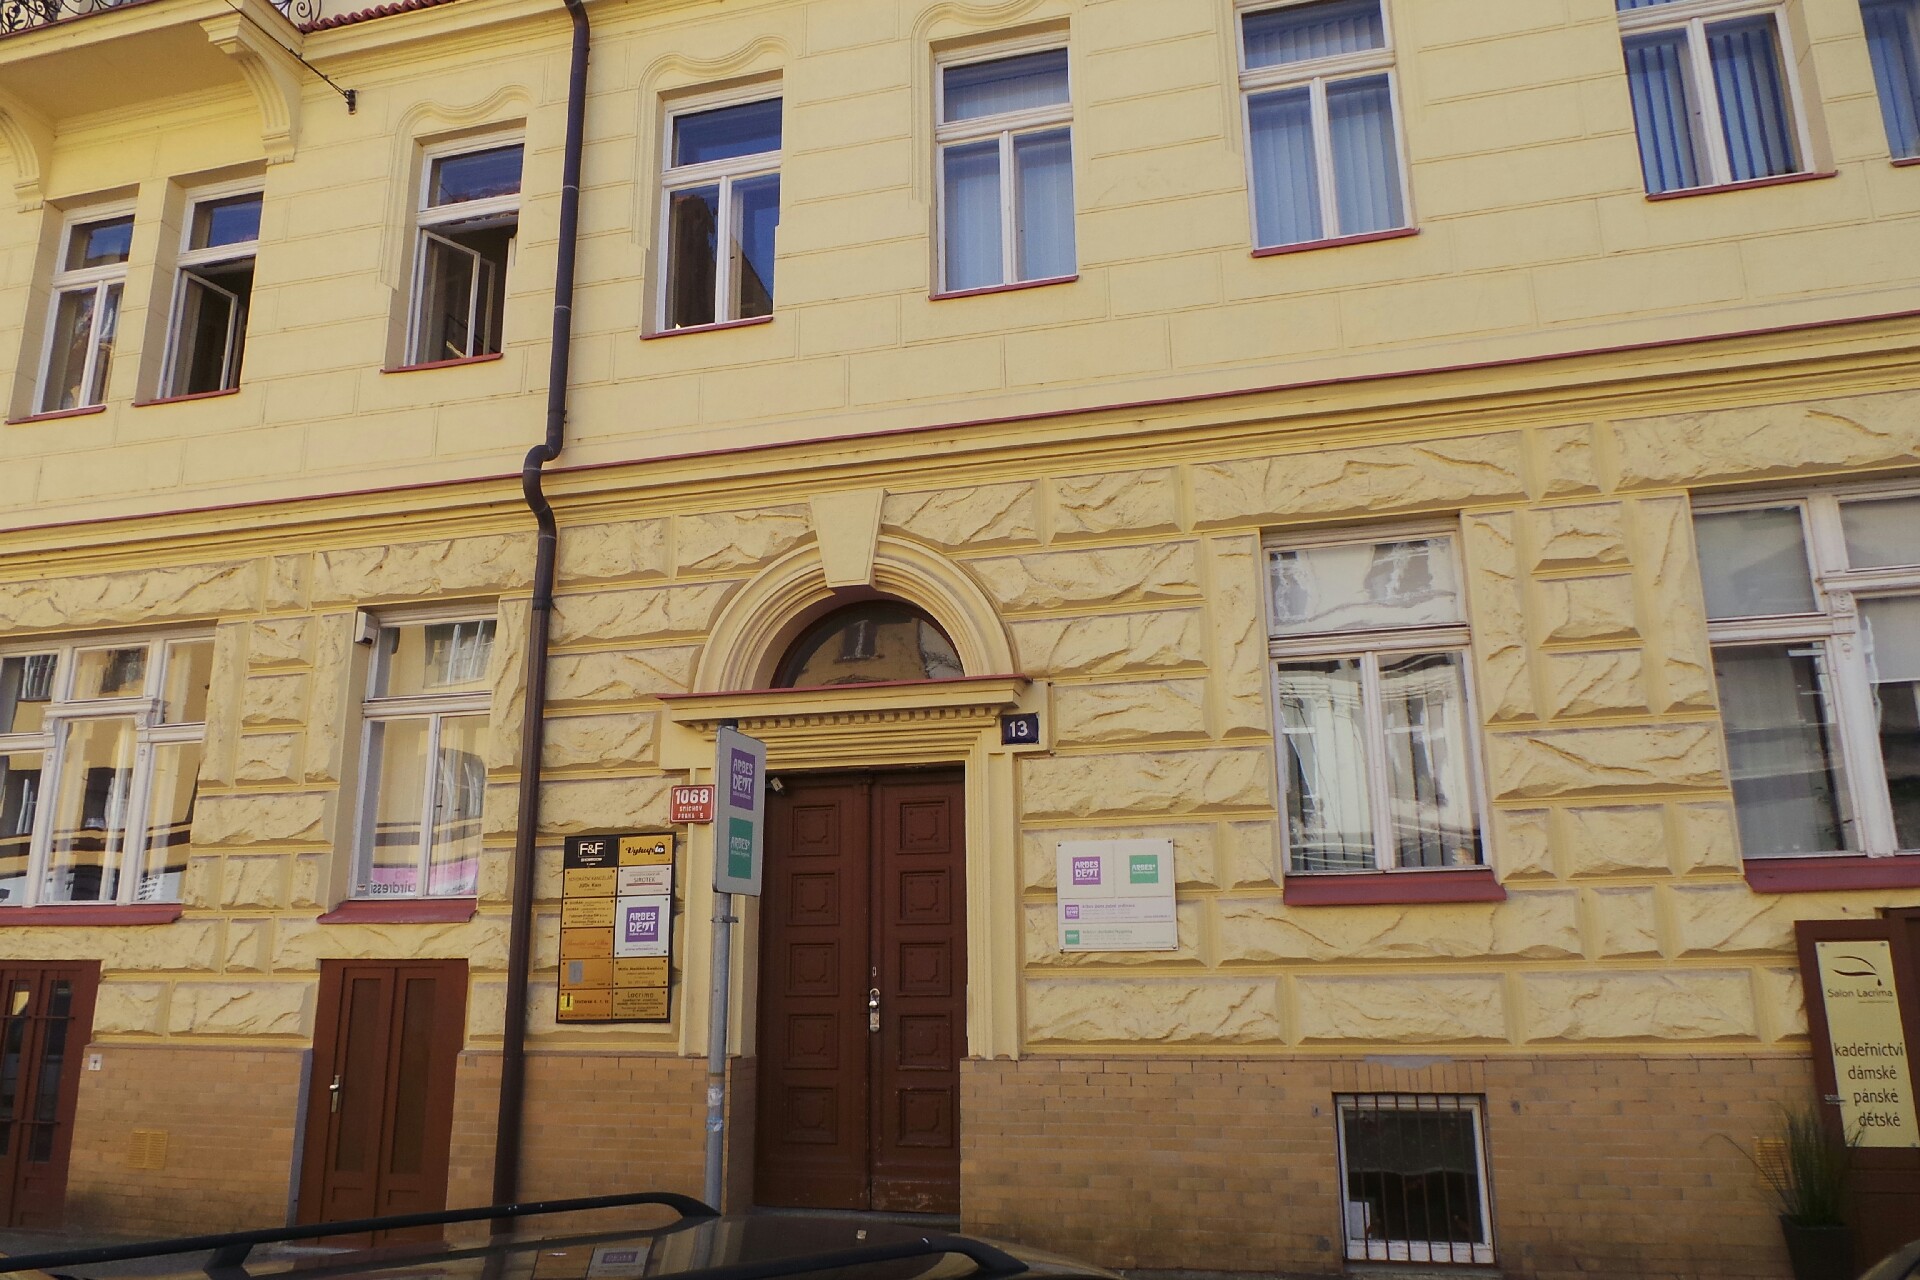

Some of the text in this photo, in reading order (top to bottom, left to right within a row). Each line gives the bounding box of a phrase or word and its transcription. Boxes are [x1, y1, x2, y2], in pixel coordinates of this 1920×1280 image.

[1010, 720, 1028, 737] 13
[733, 758, 753, 776] ARBES
[675, 788, 709, 804] 1068
[580, 842, 604, 855] F&F
[1074, 860, 1099, 869] ARBES
[1075, 868, 1099, 878] DENT
[629, 912, 656, 921] ARBES
[629, 921, 656, 932] DENT
[1827, 988, 1893, 998] Salon Lacrima
[1833, 1042, 1904, 1057] kadeřnictví
[1847, 1064, 1897, 1080] dámské
[1853, 1087, 1899, 1107] pánské
[1858, 1111, 1901, 1127] dětské
